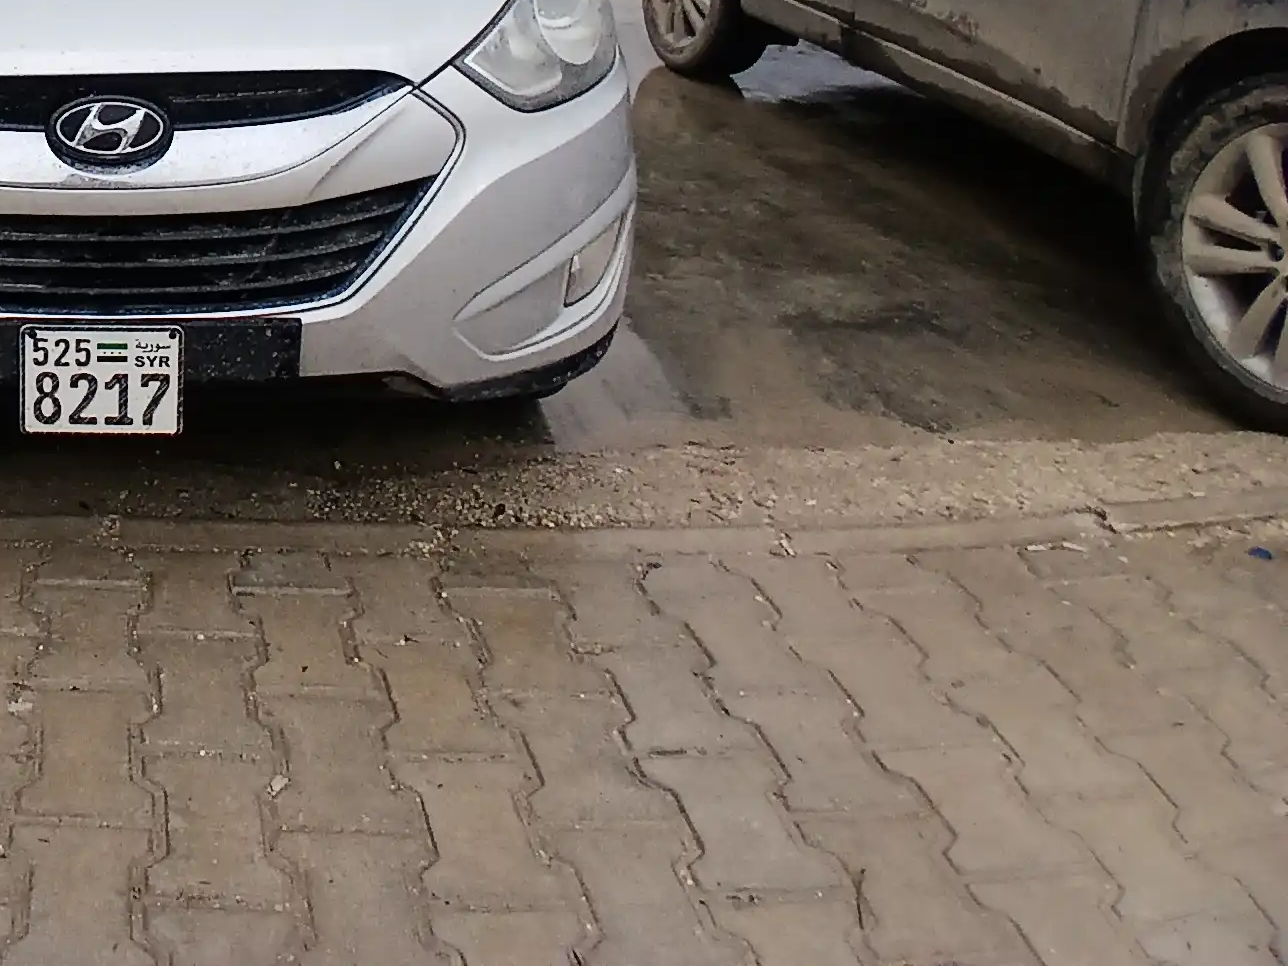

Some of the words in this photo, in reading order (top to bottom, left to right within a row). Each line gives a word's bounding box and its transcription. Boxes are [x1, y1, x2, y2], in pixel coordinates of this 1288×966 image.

[33, 338, 91, 367] 525
[135, 339, 171, 353] سورية
[134, 355, 171, 368] SYR
[33, 371, 170, 425] 8217
